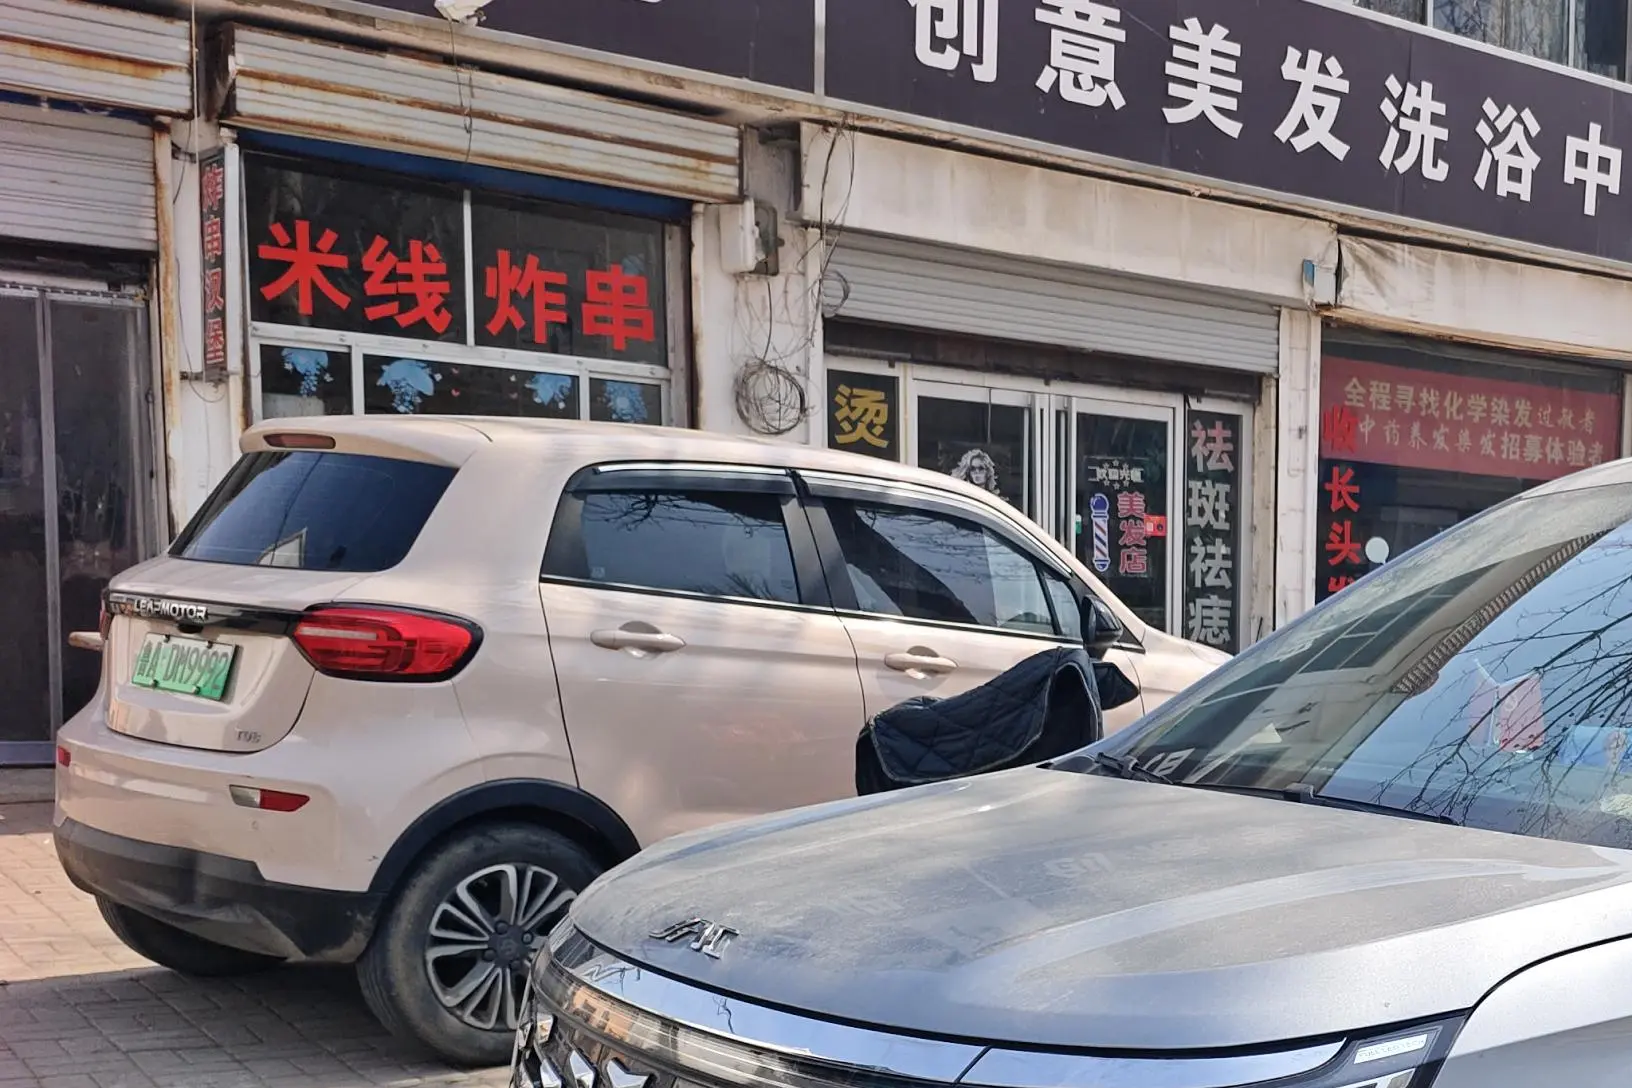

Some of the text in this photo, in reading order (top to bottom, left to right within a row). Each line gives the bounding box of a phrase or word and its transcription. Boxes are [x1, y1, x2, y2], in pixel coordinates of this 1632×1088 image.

[202, 163, 225, 364] 炸串汉堡
[257, 219, 656, 350] 米线炸串
[834, 384, 890, 448] 烫
[1117, 491, 1147, 574] 美发店
[1186, 419, 1235, 645] 祛斑祛痣
